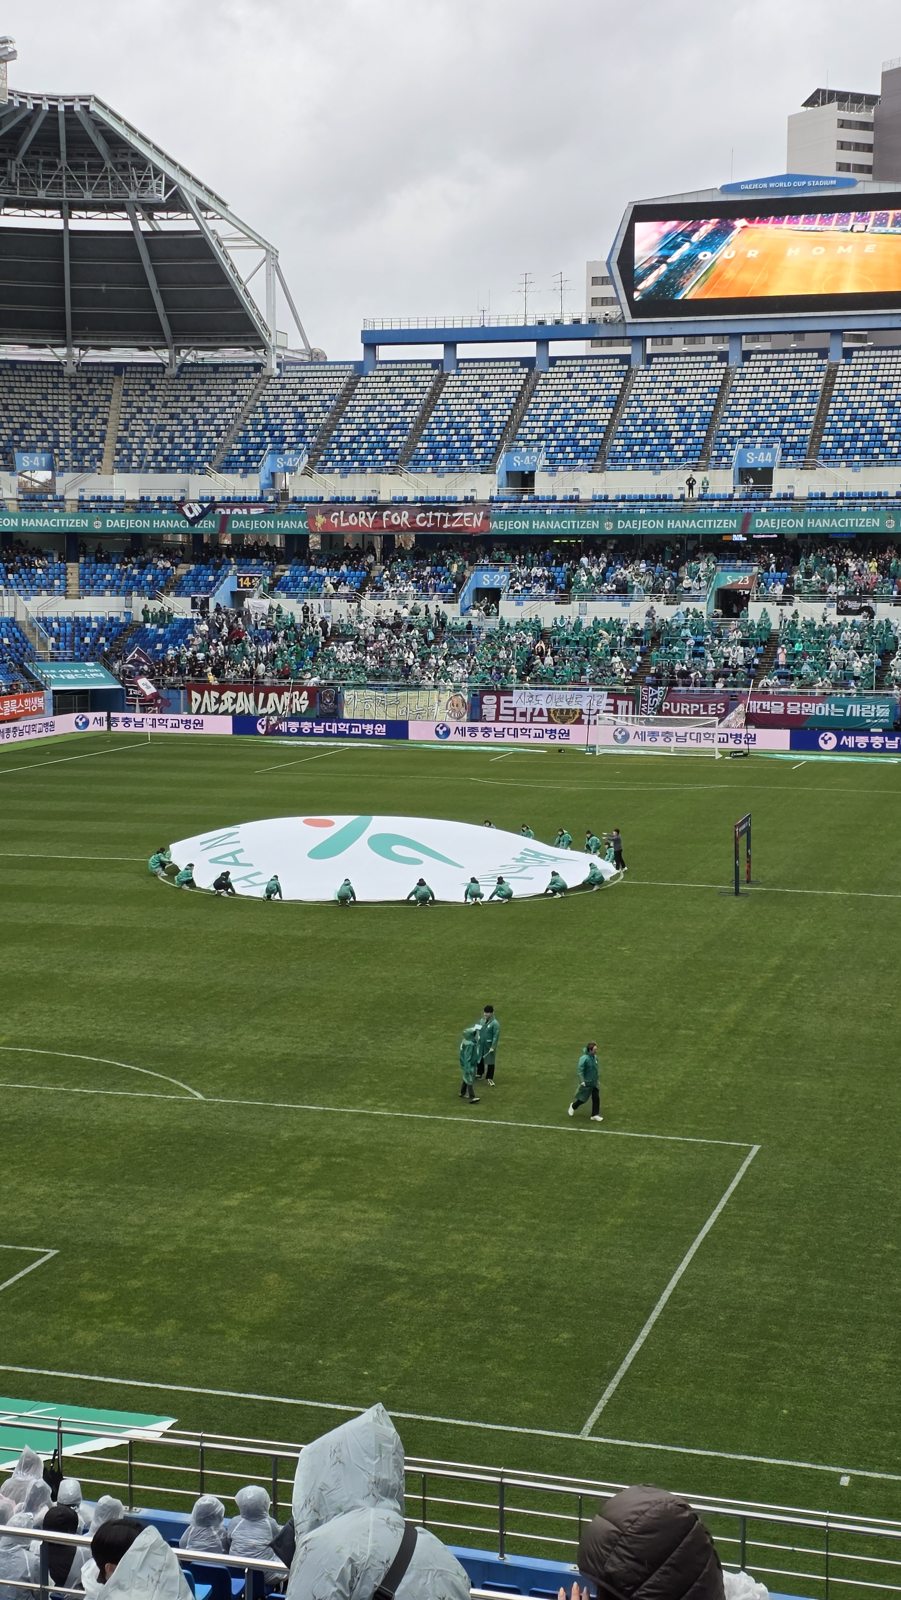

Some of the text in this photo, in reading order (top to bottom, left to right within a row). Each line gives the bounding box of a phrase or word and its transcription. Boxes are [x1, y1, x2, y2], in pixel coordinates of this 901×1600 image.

[807, 179, 837, 187] STADIUM
[698, 244, 877, 260] OUR HOME
[22, 455, 46, 468] S-41
[276, 456, 300, 469] S-42
[746, 452, 773, 464] S-44
[21, 518, 88, 528] HANACITIZEN
[106, 519, 216, 530] DAEJEON HANACIZEN
[231, 519, 275, 531] DAEJEON
[330, 509, 484, 529] GLORY FOR CITIZEN
[532, 520, 600, 530] HANACITIZEN
[617, 519, 737, 531] DAEJEON HANACITIZEN
[755, 518, 880, 530] DAEJEON HANACITIZEN
[238, 576, 251, 588] 14
[482, 574, 508, 586] S-22
[726, 575, 750, 586] S-23
[191, 690, 255, 714] DAEJEON
[661, 702, 726, 715] PURPLES
[786, 701, 845, 717] 응원하는
[846, 704, 891, 718] 사람들
[454, 726, 571, 741] 세종충남대학교병원
[633, 731, 757, 745] 세종충남대학교병원
